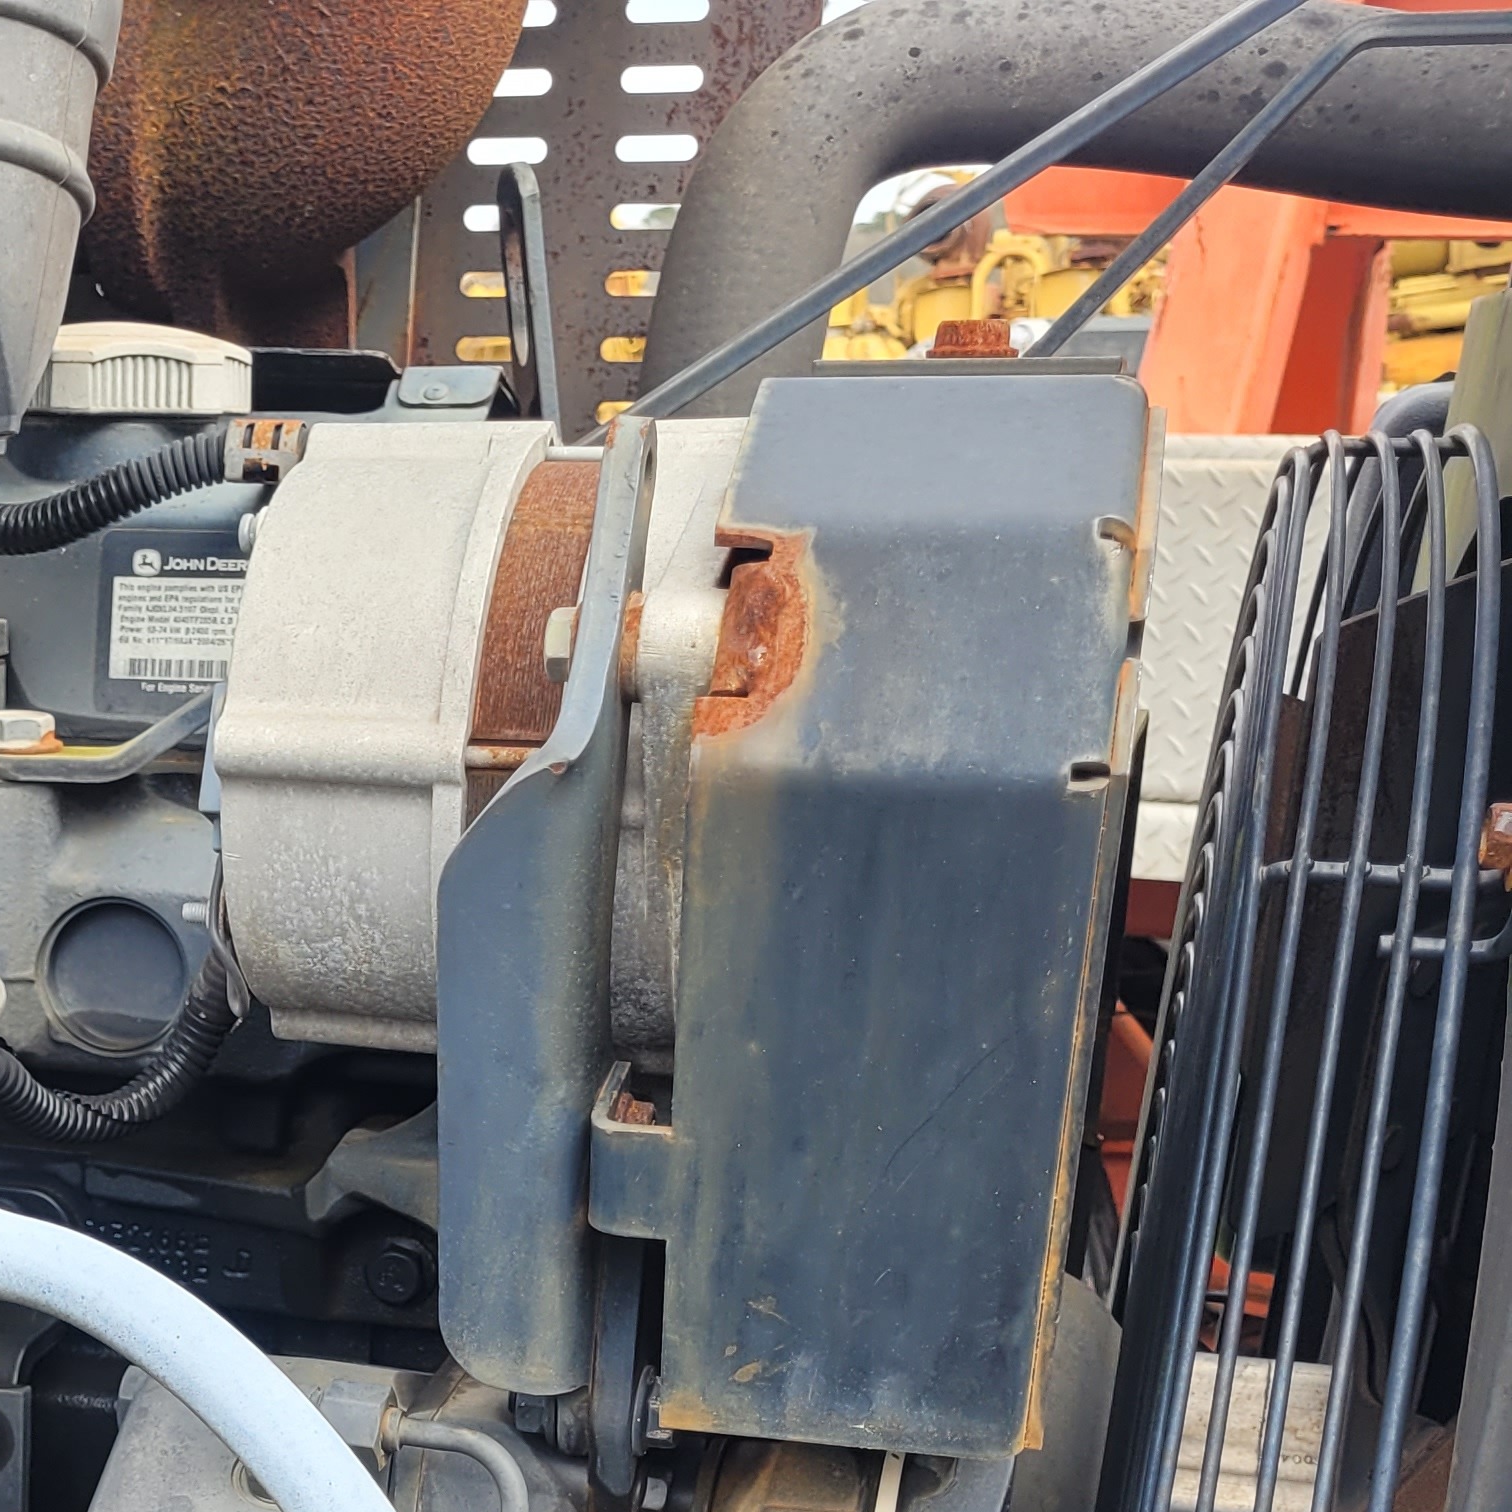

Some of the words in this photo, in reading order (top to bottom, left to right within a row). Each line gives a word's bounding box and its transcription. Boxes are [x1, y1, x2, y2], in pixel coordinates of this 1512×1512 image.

[163, 556, 205, 571] JOHN
[206, 556, 249, 571] DEER
[137, 584, 162, 593] engine
[164, 594, 179, 602] EPA
